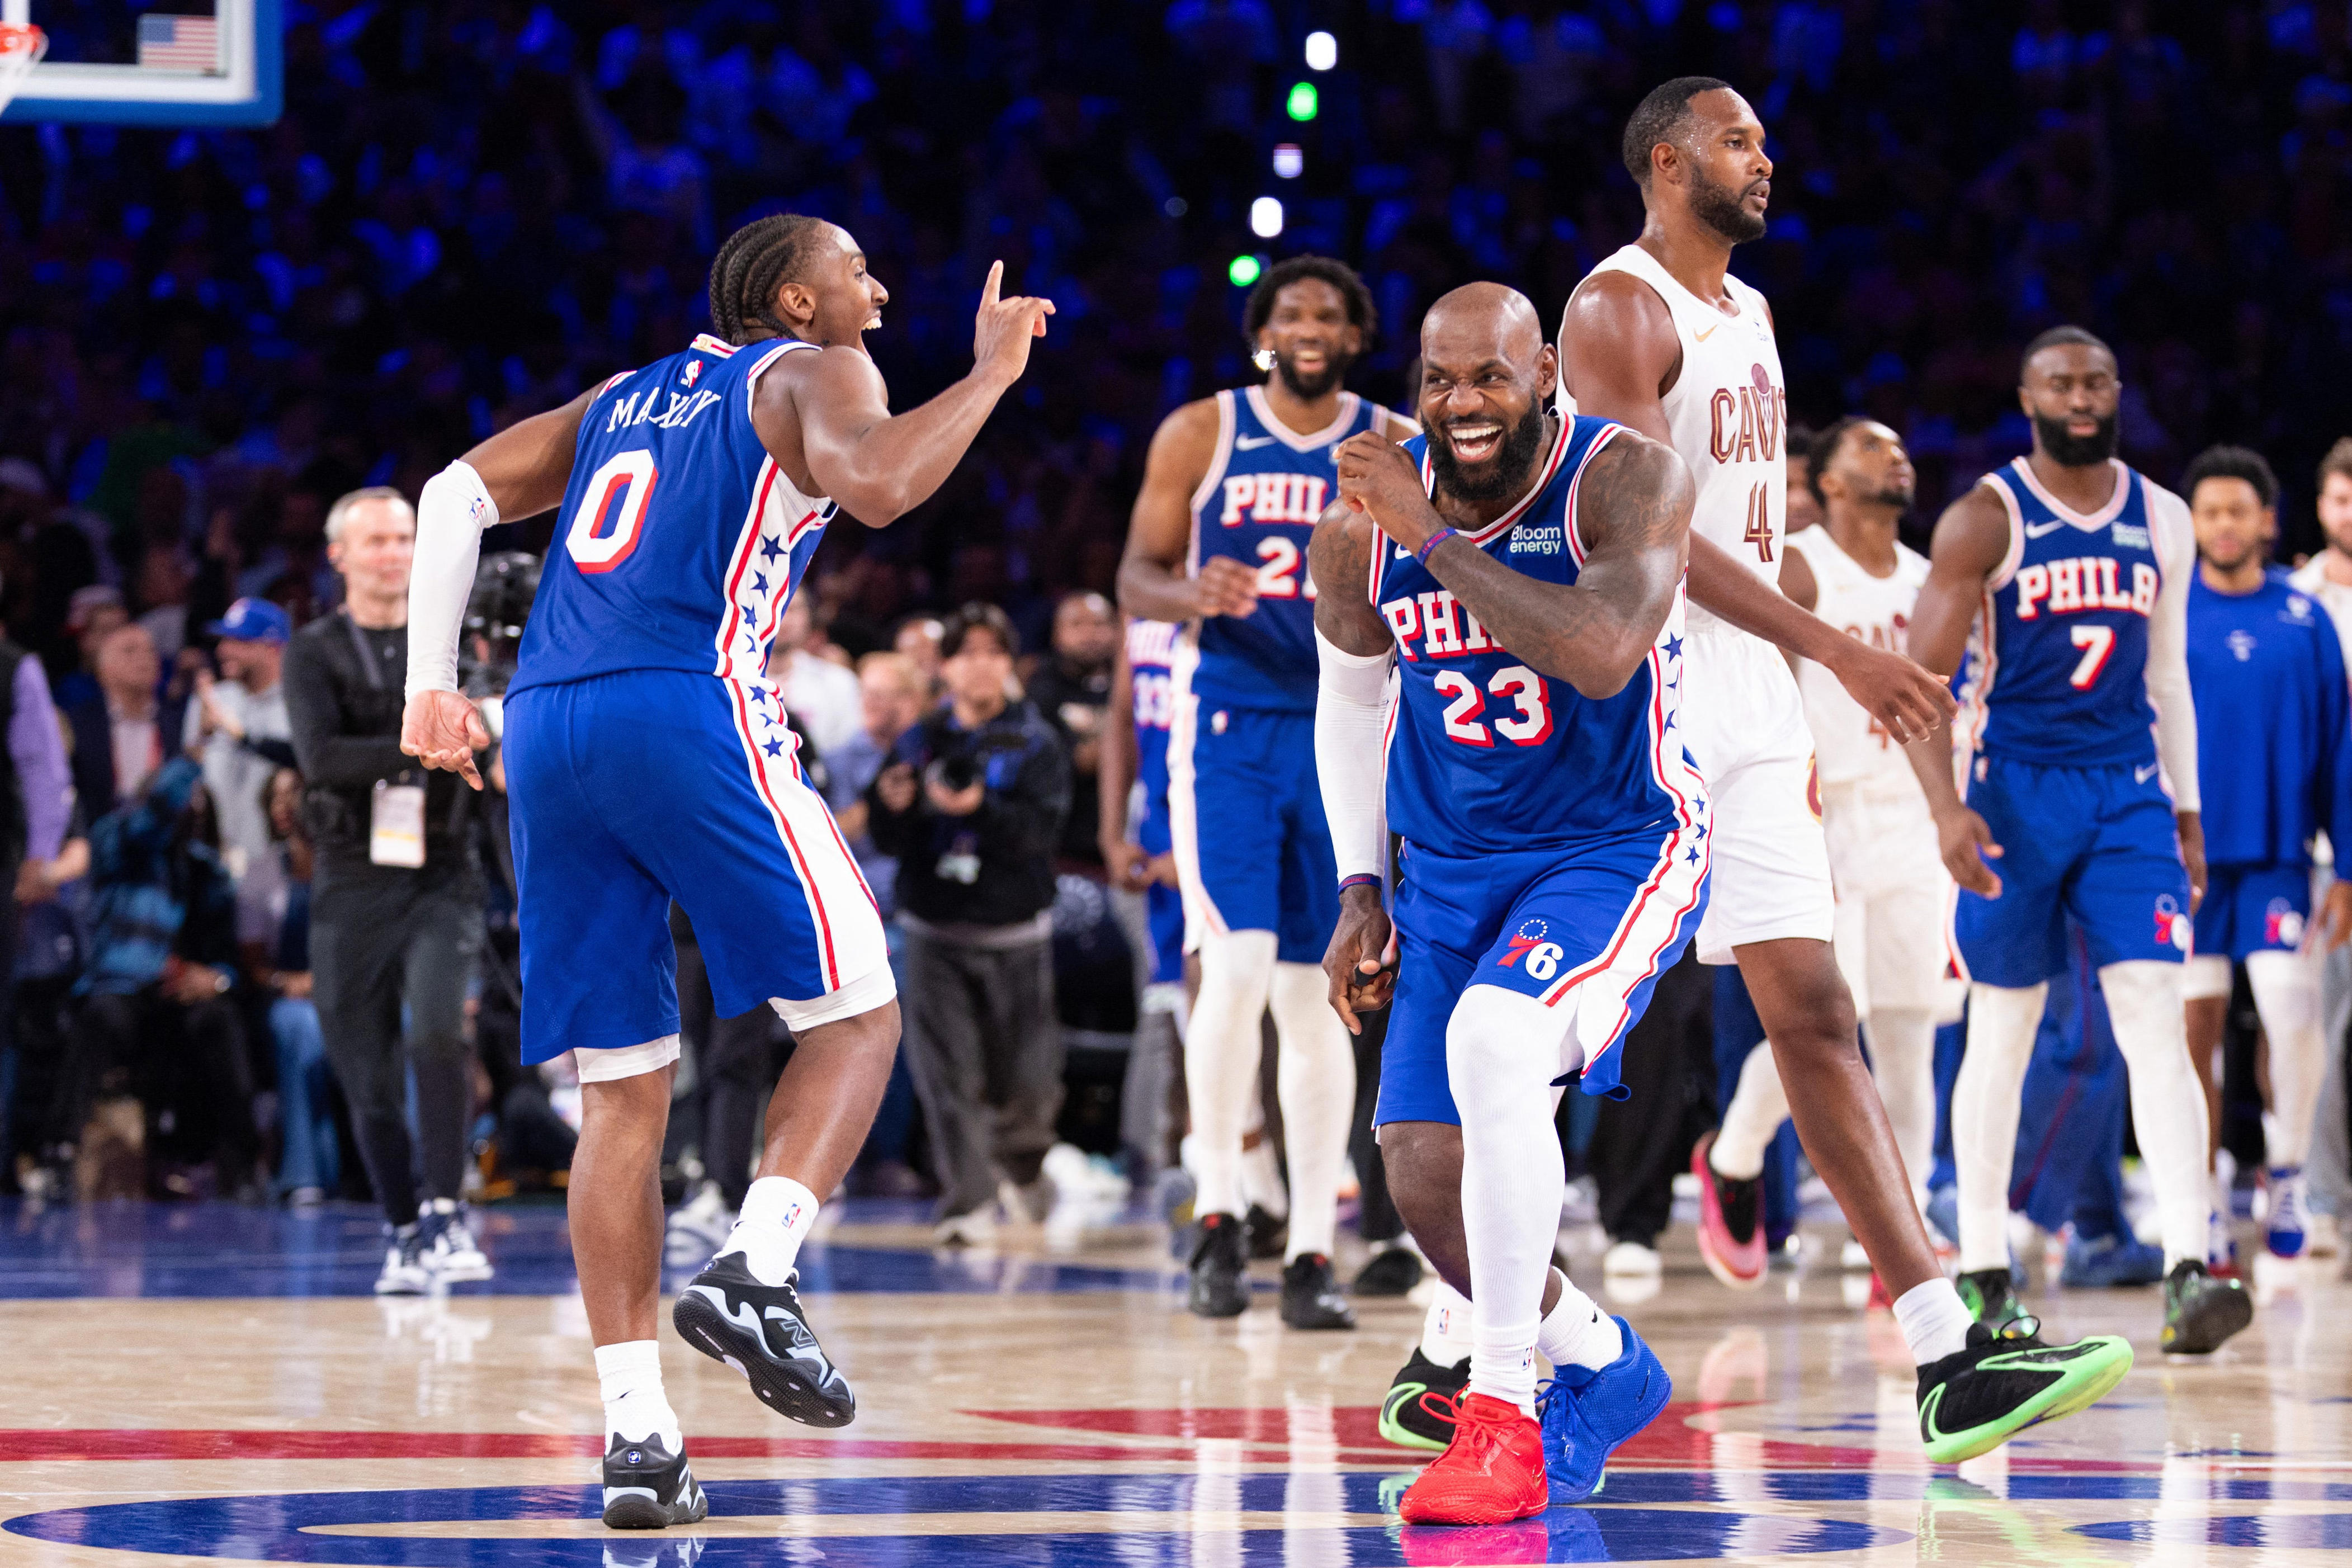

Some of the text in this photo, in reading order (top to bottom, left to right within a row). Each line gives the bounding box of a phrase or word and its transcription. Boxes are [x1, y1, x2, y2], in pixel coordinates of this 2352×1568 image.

[565, 449, 658, 574] 0
[1220, 473, 1329, 527] PHIL
[1512, 525, 1561, 541] Bloom
[1744, 480, 1774, 563] 4
[1510, 540, 1561, 555] energy
[1381, 590, 1506, 662] PHI
[2070, 625, 2117, 692] 7
[1433, 665, 1553, 748] 23
[1497, 933, 1564, 981] 76
